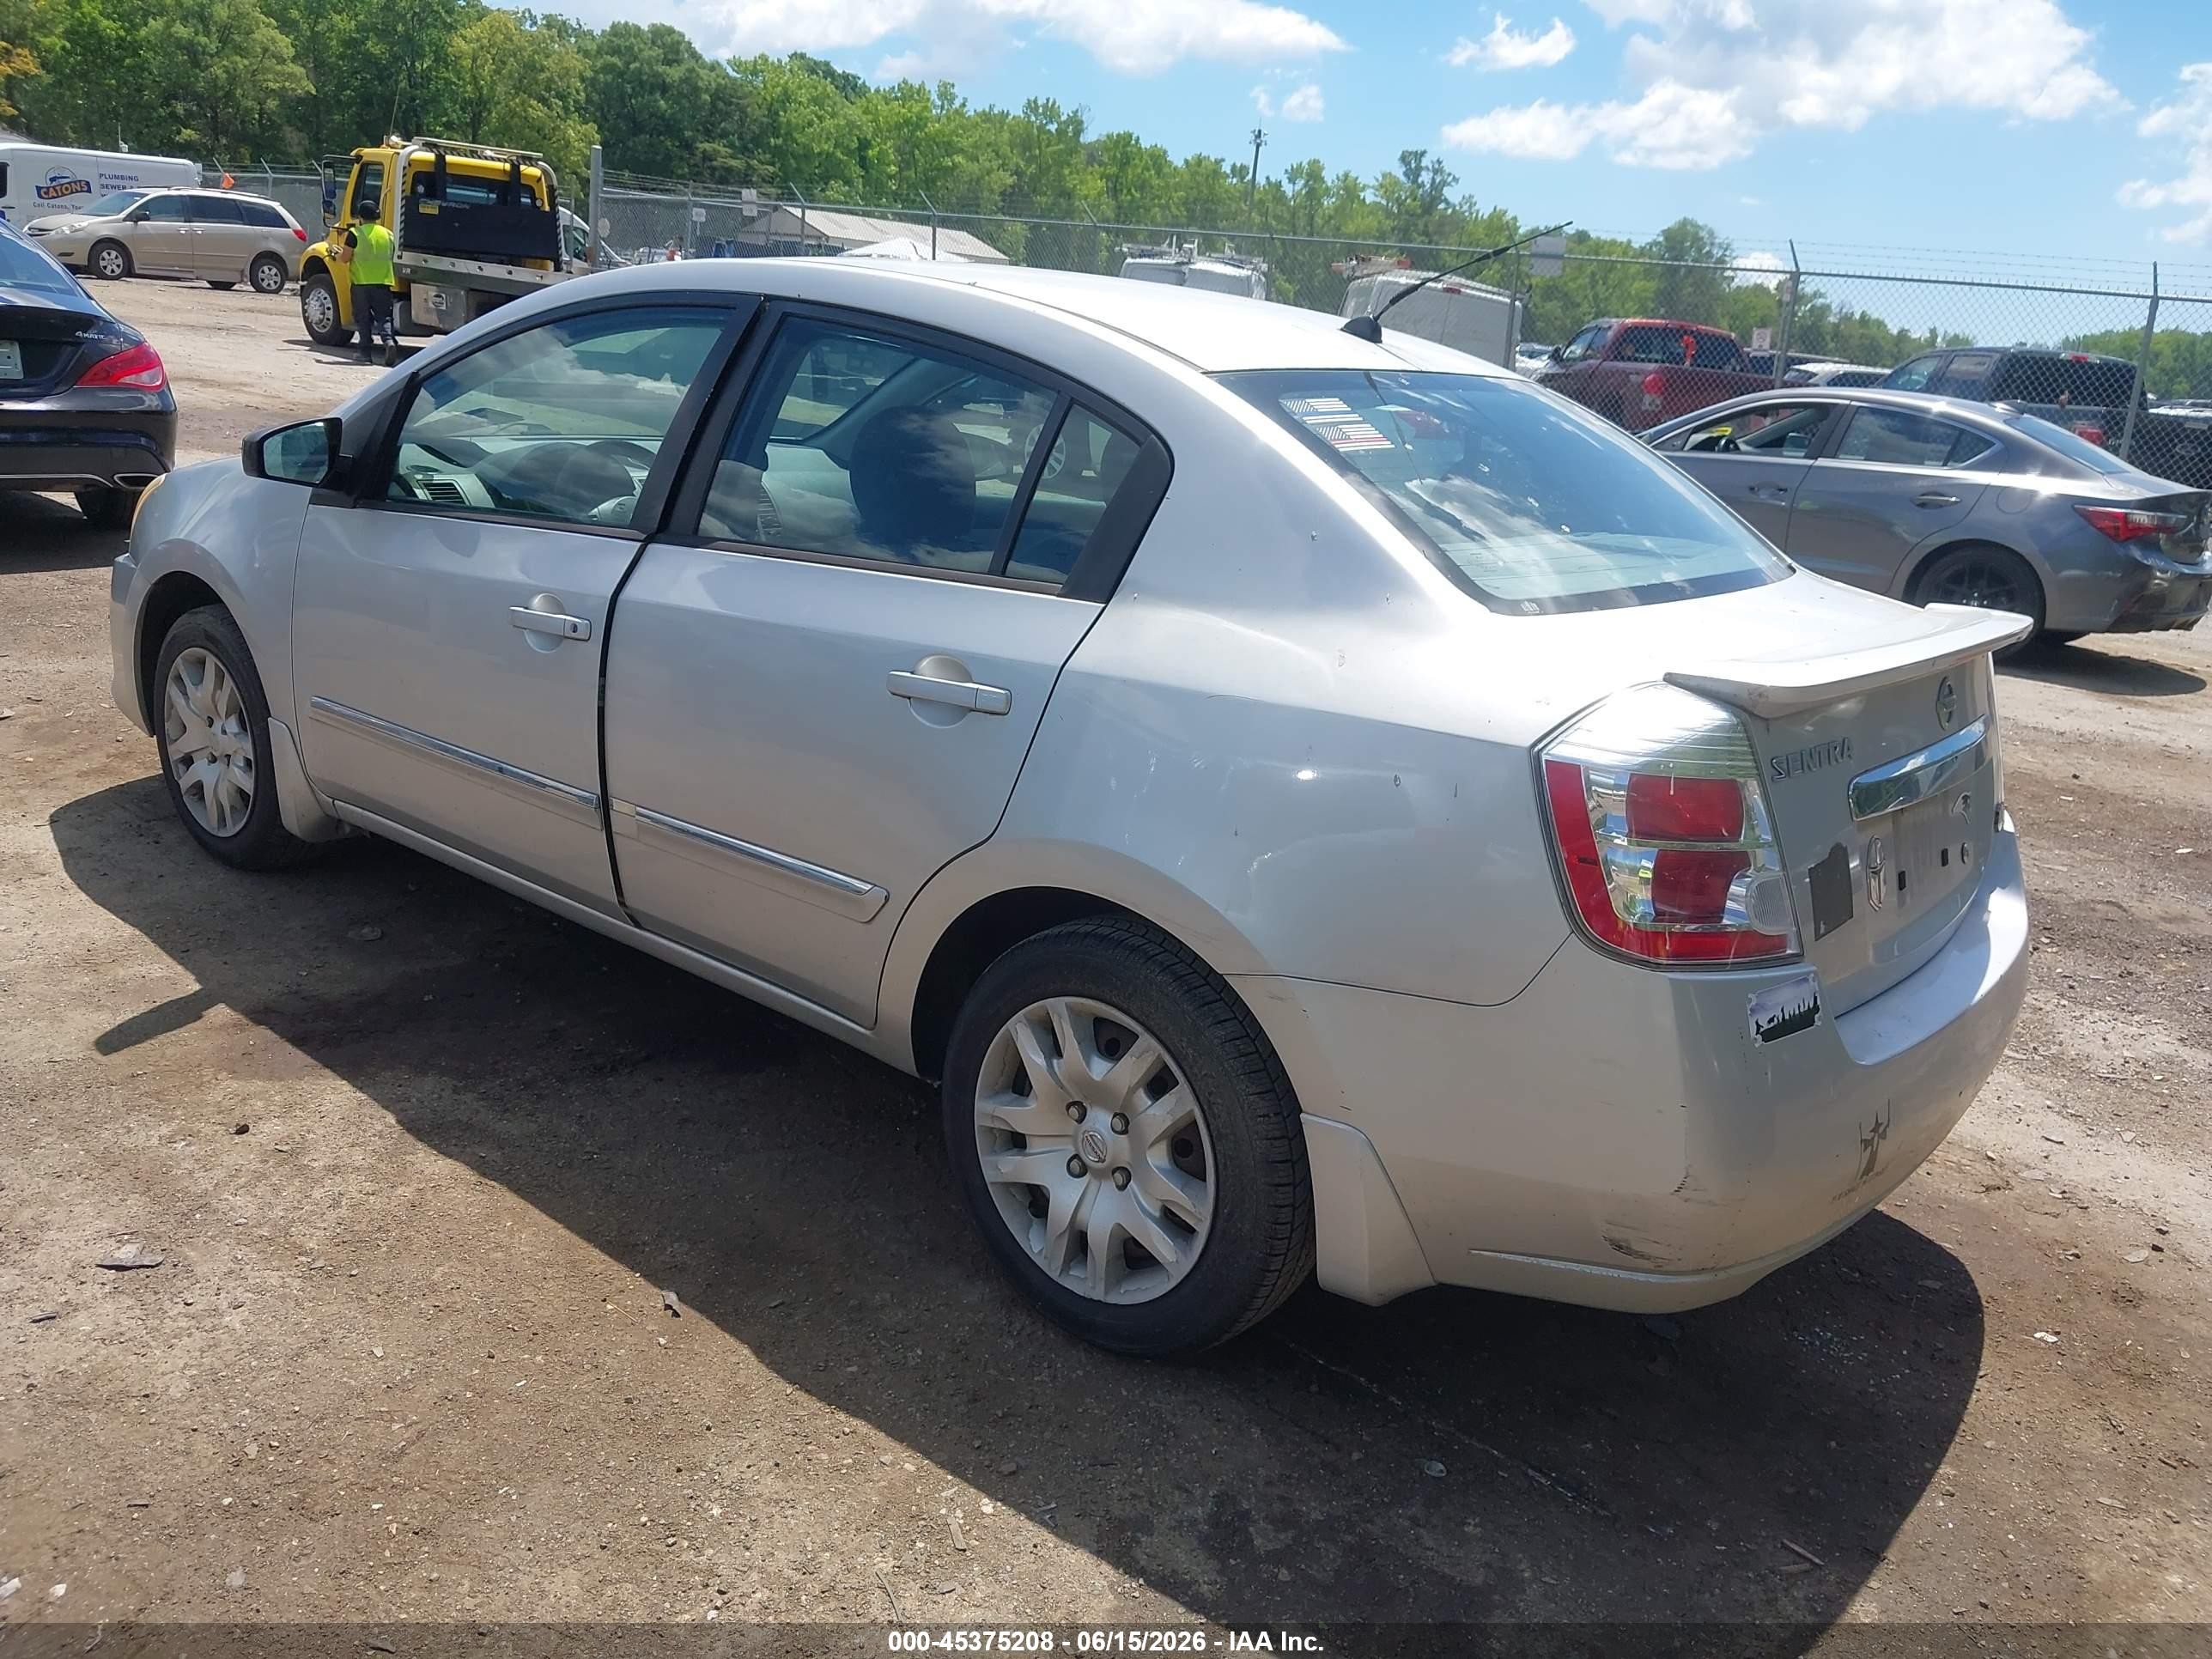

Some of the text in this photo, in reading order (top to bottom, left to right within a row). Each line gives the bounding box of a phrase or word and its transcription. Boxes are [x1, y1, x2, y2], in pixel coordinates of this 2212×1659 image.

[99, 173, 139, 182] PLUMBING
[40, 180, 88, 198] CATONS
[1771, 736, 1853, 781] SENTRA
